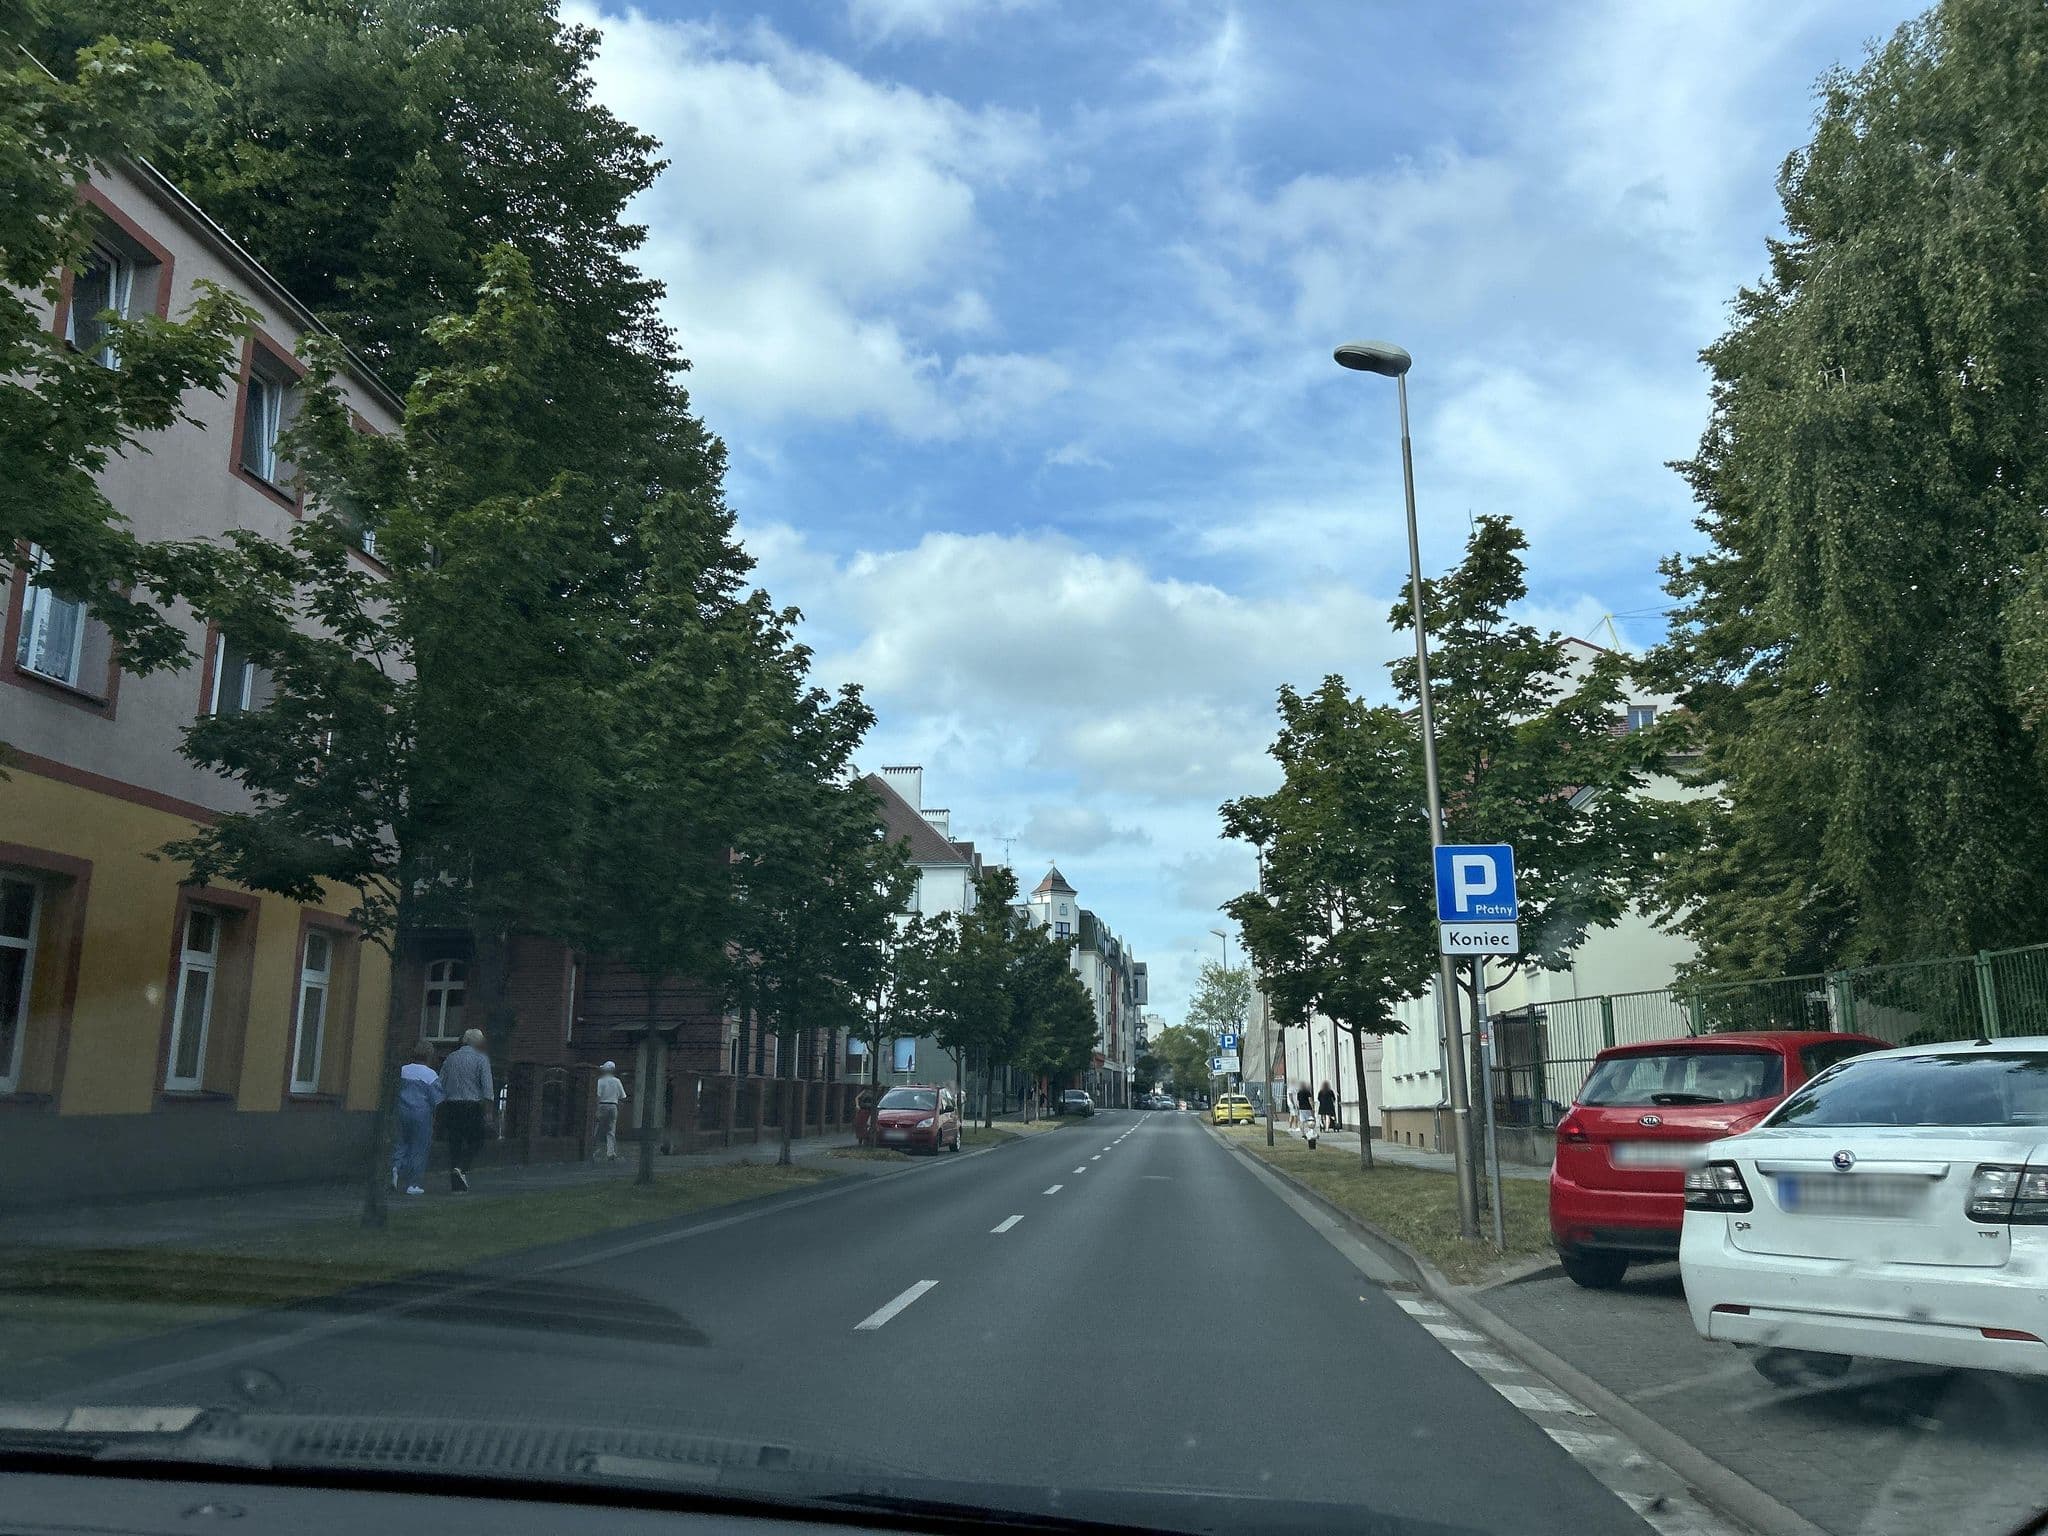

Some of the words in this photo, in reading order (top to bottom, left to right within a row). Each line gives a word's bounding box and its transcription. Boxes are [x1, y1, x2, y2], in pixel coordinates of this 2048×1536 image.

[1452, 854, 1497, 912] P
[1475, 904, 1513, 917] Płatny
[1449, 931, 1510, 946] Koniec
[1224, 1035, 1234, 1048] P
